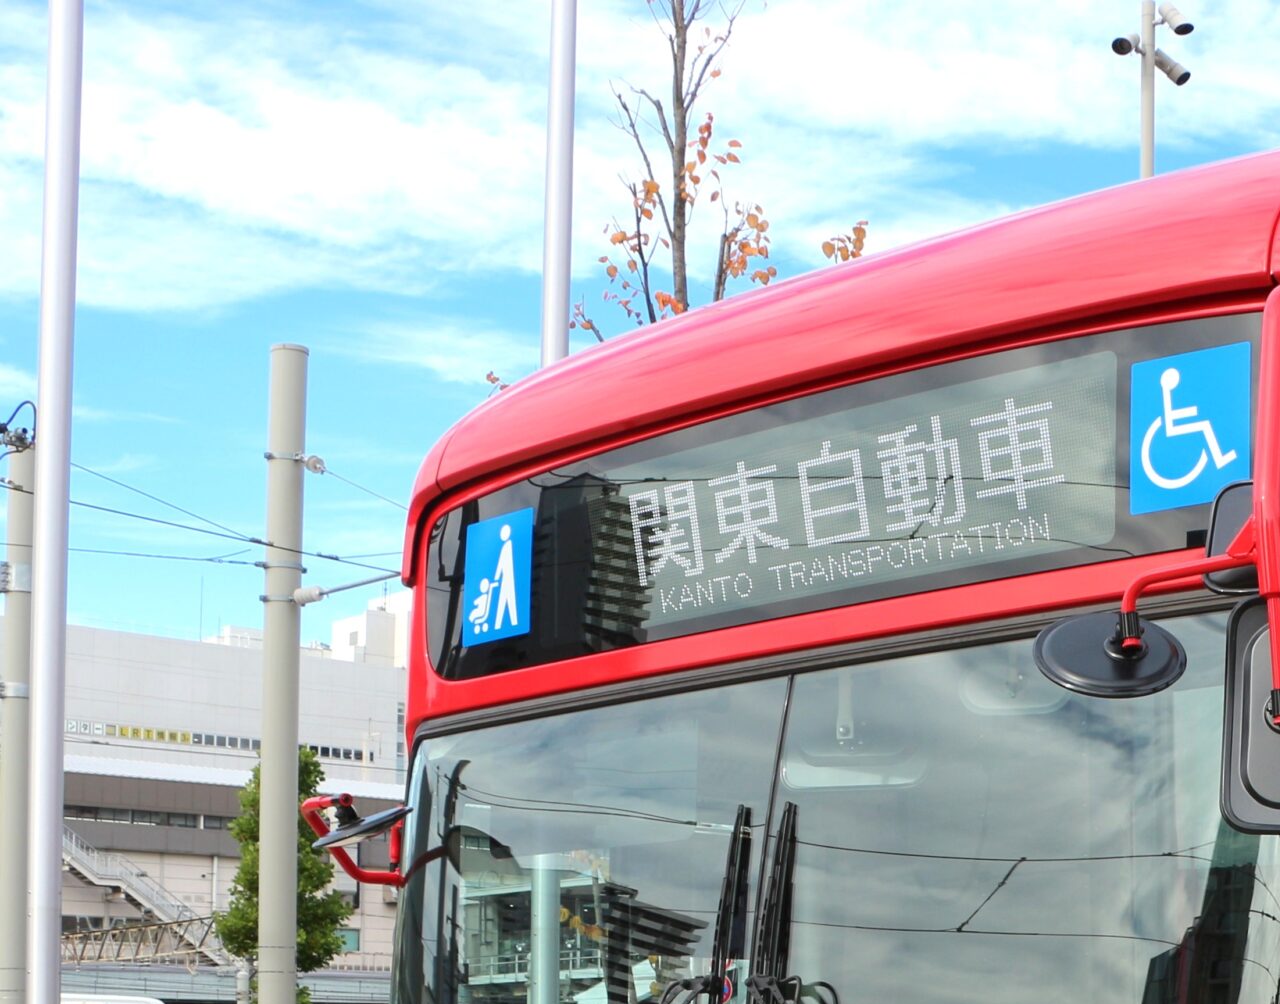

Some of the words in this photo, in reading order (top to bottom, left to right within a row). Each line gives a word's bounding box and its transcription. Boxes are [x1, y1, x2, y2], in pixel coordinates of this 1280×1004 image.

[628, 398, 1065, 586] 関東自動車
[659, 572, 754, 614] KANTO
[768, 513, 1051, 592] TRANSPORTATION
